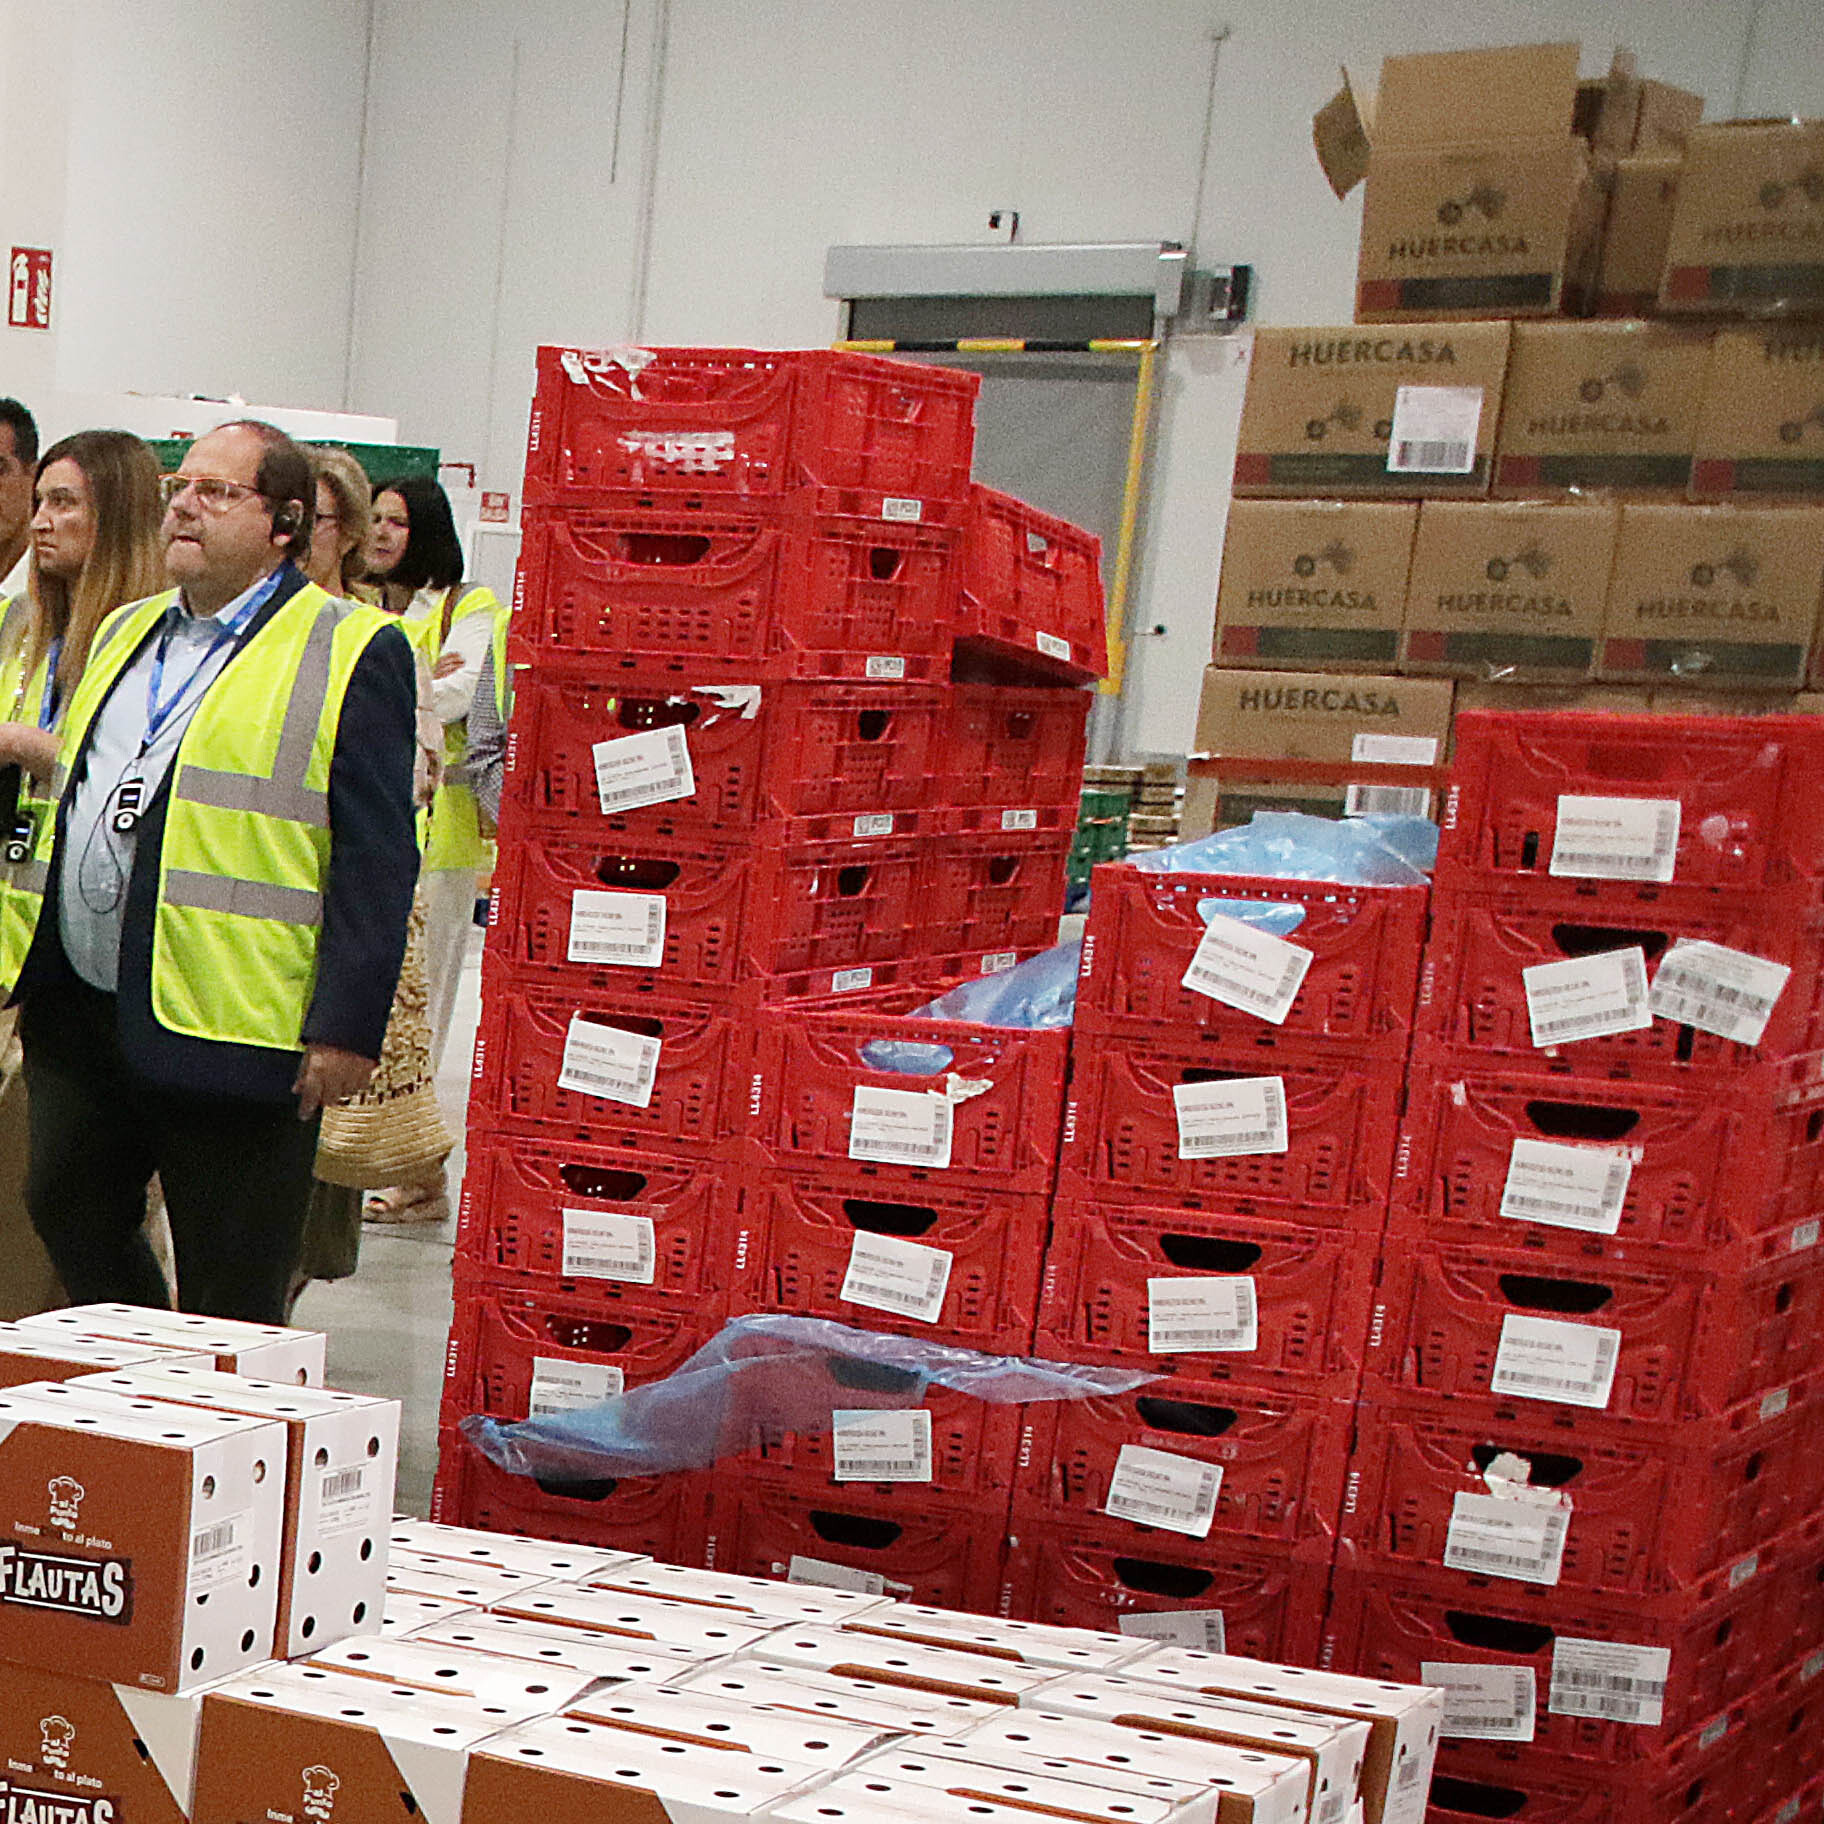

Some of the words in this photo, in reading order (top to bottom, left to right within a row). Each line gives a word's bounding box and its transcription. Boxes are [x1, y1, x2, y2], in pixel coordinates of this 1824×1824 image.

[1388, 235, 1529, 262] HUERCASA
[1290, 340, 1457, 367] HUERCASA
[1529, 415, 1670, 438] HUERCASA
[1247, 587, 1377, 613] HUERCASA
[1438, 591, 1573, 618] HUERCASA
[1636, 599, 1781, 625] HUERCASA
[1239, 688, 1401, 716] HUERCASA
